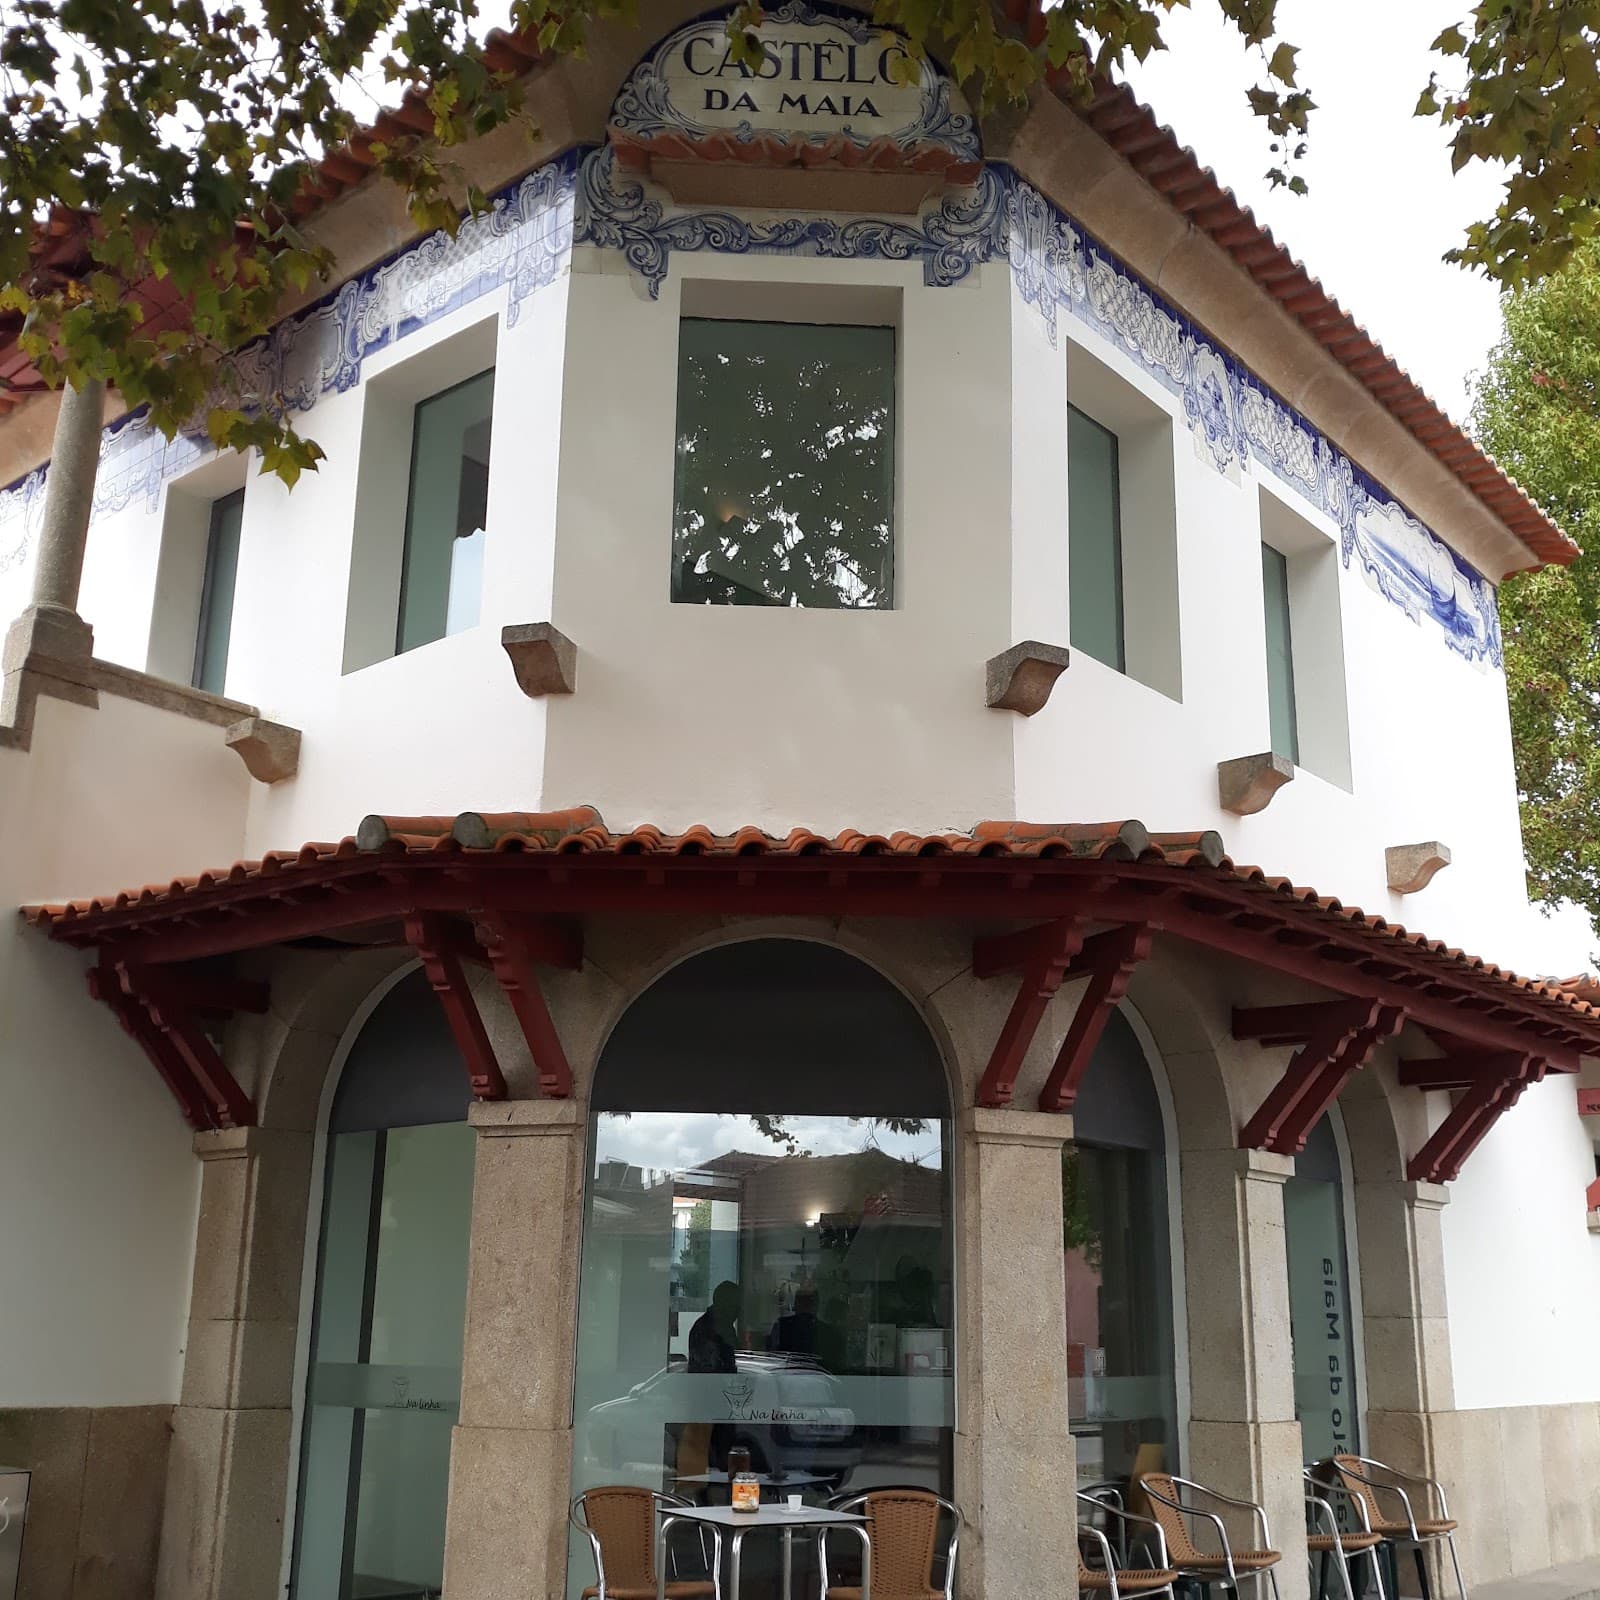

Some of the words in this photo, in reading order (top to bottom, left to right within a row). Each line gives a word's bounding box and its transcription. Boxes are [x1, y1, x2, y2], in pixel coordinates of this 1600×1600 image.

[704, 88, 761, 112] DA
[778, 92, 884, 118] MAIA
[750, 1409, 769, 1420] Na
[771, 1408, 805, 1420] linha
